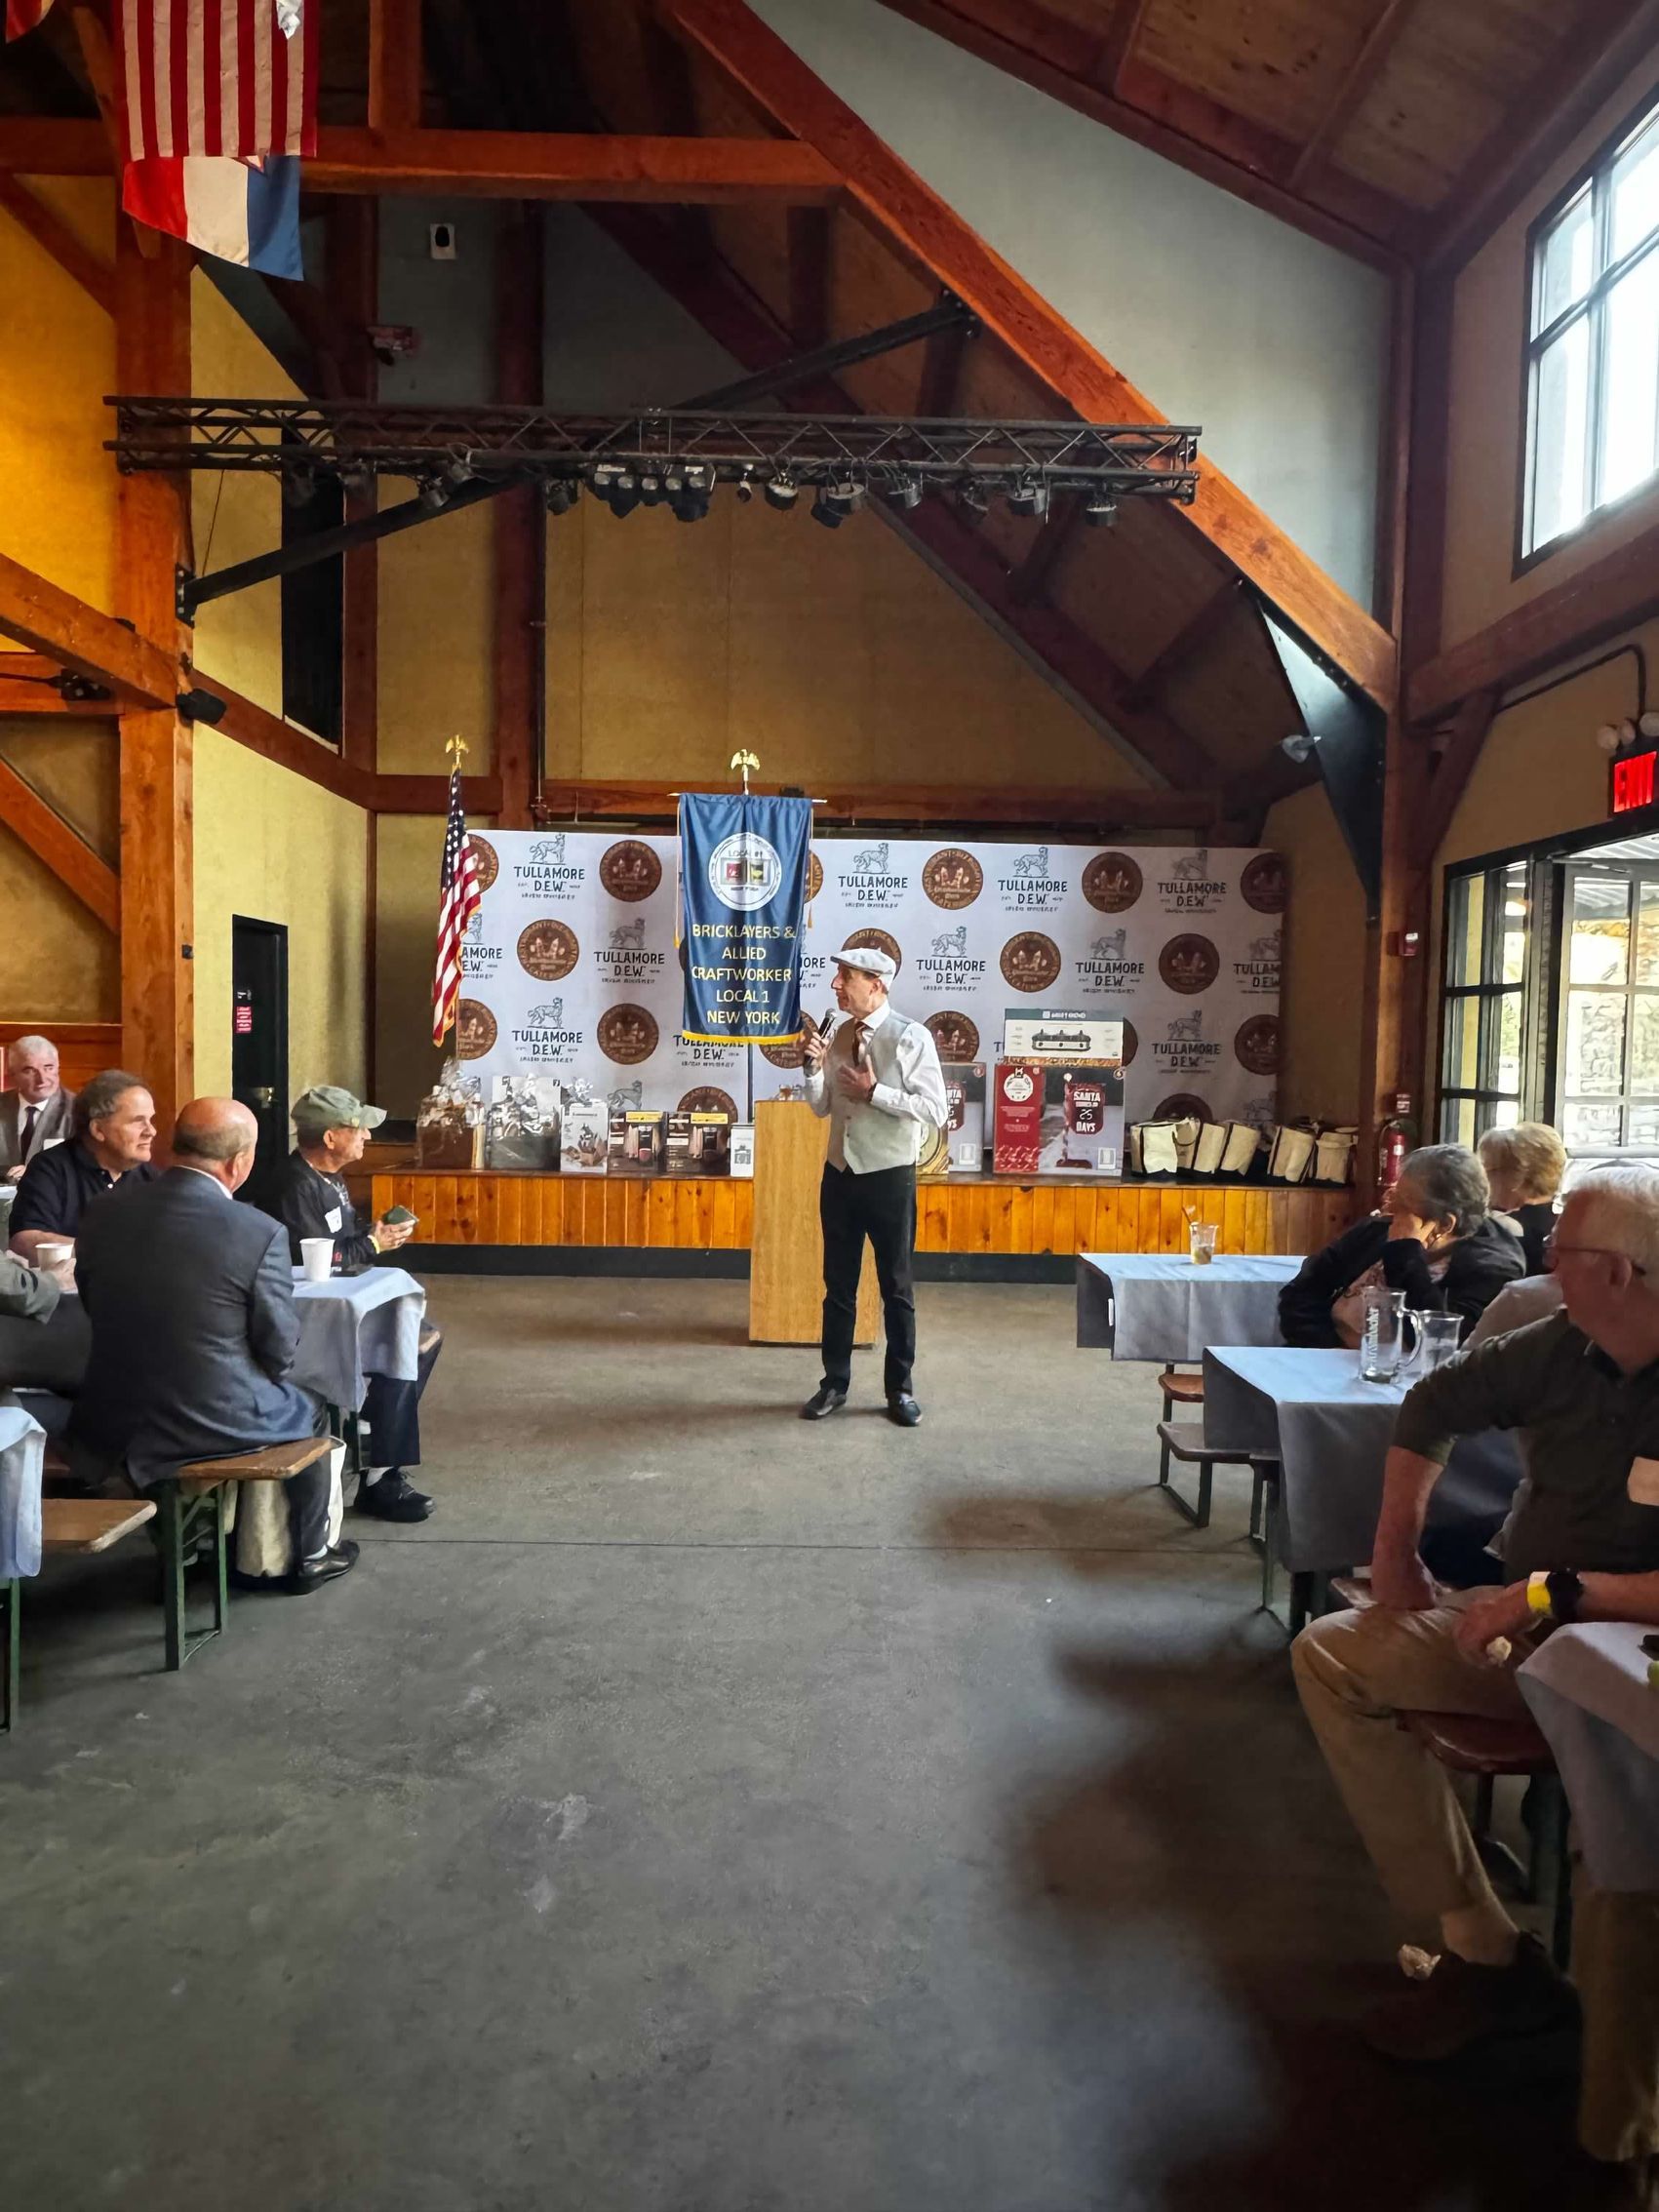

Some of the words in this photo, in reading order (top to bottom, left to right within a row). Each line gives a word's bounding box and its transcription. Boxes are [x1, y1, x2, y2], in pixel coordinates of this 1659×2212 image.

[513, 866, 585, 880] TULLAMORE
[838, 876, 908, 889] TULLAMORE
[997, 880, 1068, 892] TULLAMORE
[1158, 882, 1227, 894] TULLAMORE
[692, 923, 780, 938] BRICKLAYERS
[784, 925, 796, 939] &
[462, 946, 502, 959] AMORE
[593, 951, 665, 965] TULLAMORE
[722, 946, 767, 961] ALLIED
[916, 959, 986, 971] TULLAMORE
[1075, 962, 1145, 973] TULLAMORE
[691, 967, 792, 982] CRAFTWORKER
[716, 988, 759, 1004] LOCAL
[762, 989, 770, 1004] 1
[707, 1009, 740, 1025] NEW
[744, 1009, 781, 1025] YORK
[511, 1030, 583, 1044] TULLAMORE
[1151, 1043, 1222, 1055] TULLAMORE
[1073, 1090, 1101, 1102] SANTA
[1076, 1121, 1096, 1132] DAYS
